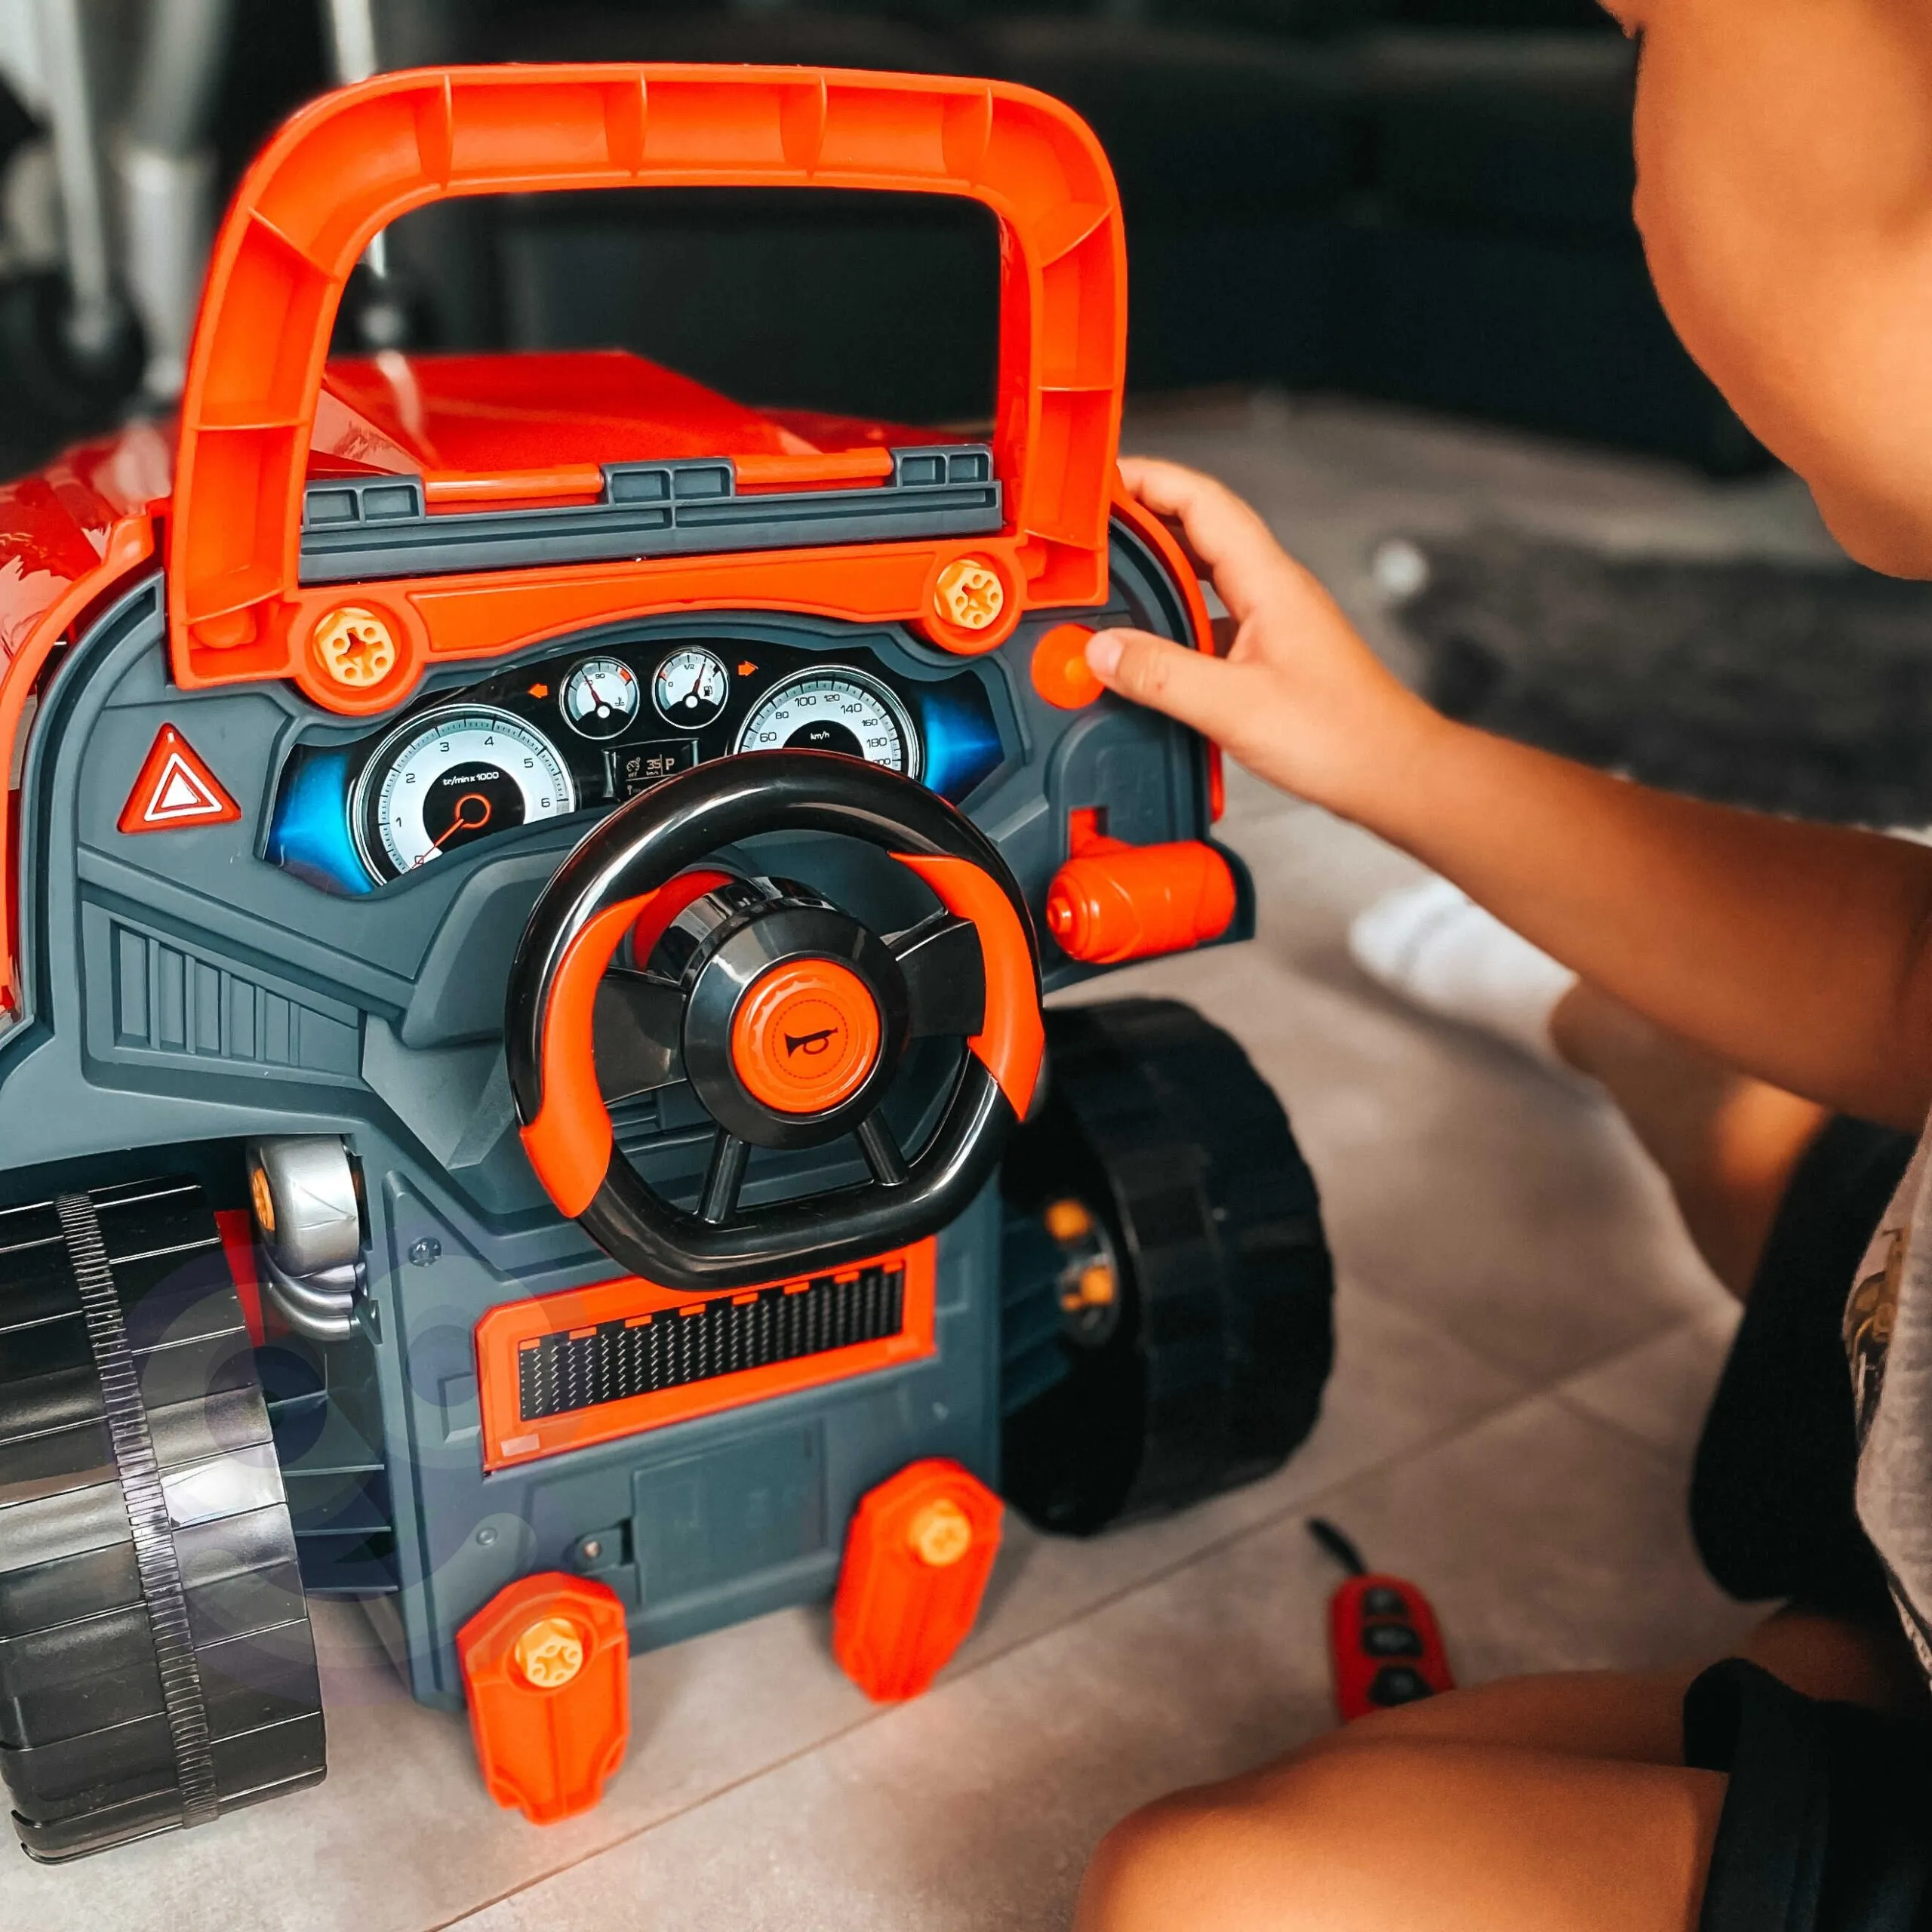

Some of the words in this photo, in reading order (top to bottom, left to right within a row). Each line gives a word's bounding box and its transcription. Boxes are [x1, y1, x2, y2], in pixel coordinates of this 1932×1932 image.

[794, 696, 817, 707] 100
[824, 694, 841, 703] 120
[840, 703, 863, 715] 140
[775, 711, 789, 720] 80
[862, 718, 878, 727] 160
[759, 731, 777, 743] 60
[810, 731, 830, 740] km/h
[484, 736, 495, 746] 4
[866, 737, 888, 749] 180
[440, 742, 451, 752] 3
[524, 758, 534, 768] 5
[646, 758, 661, 770] 35
[665, 758, 675, 771] P
[405, 773, 416, 784] 2
[475, 771, 500, 781] 1000
[540, 797, 551, 808] 6
[395, 817, 402, 828] 1
